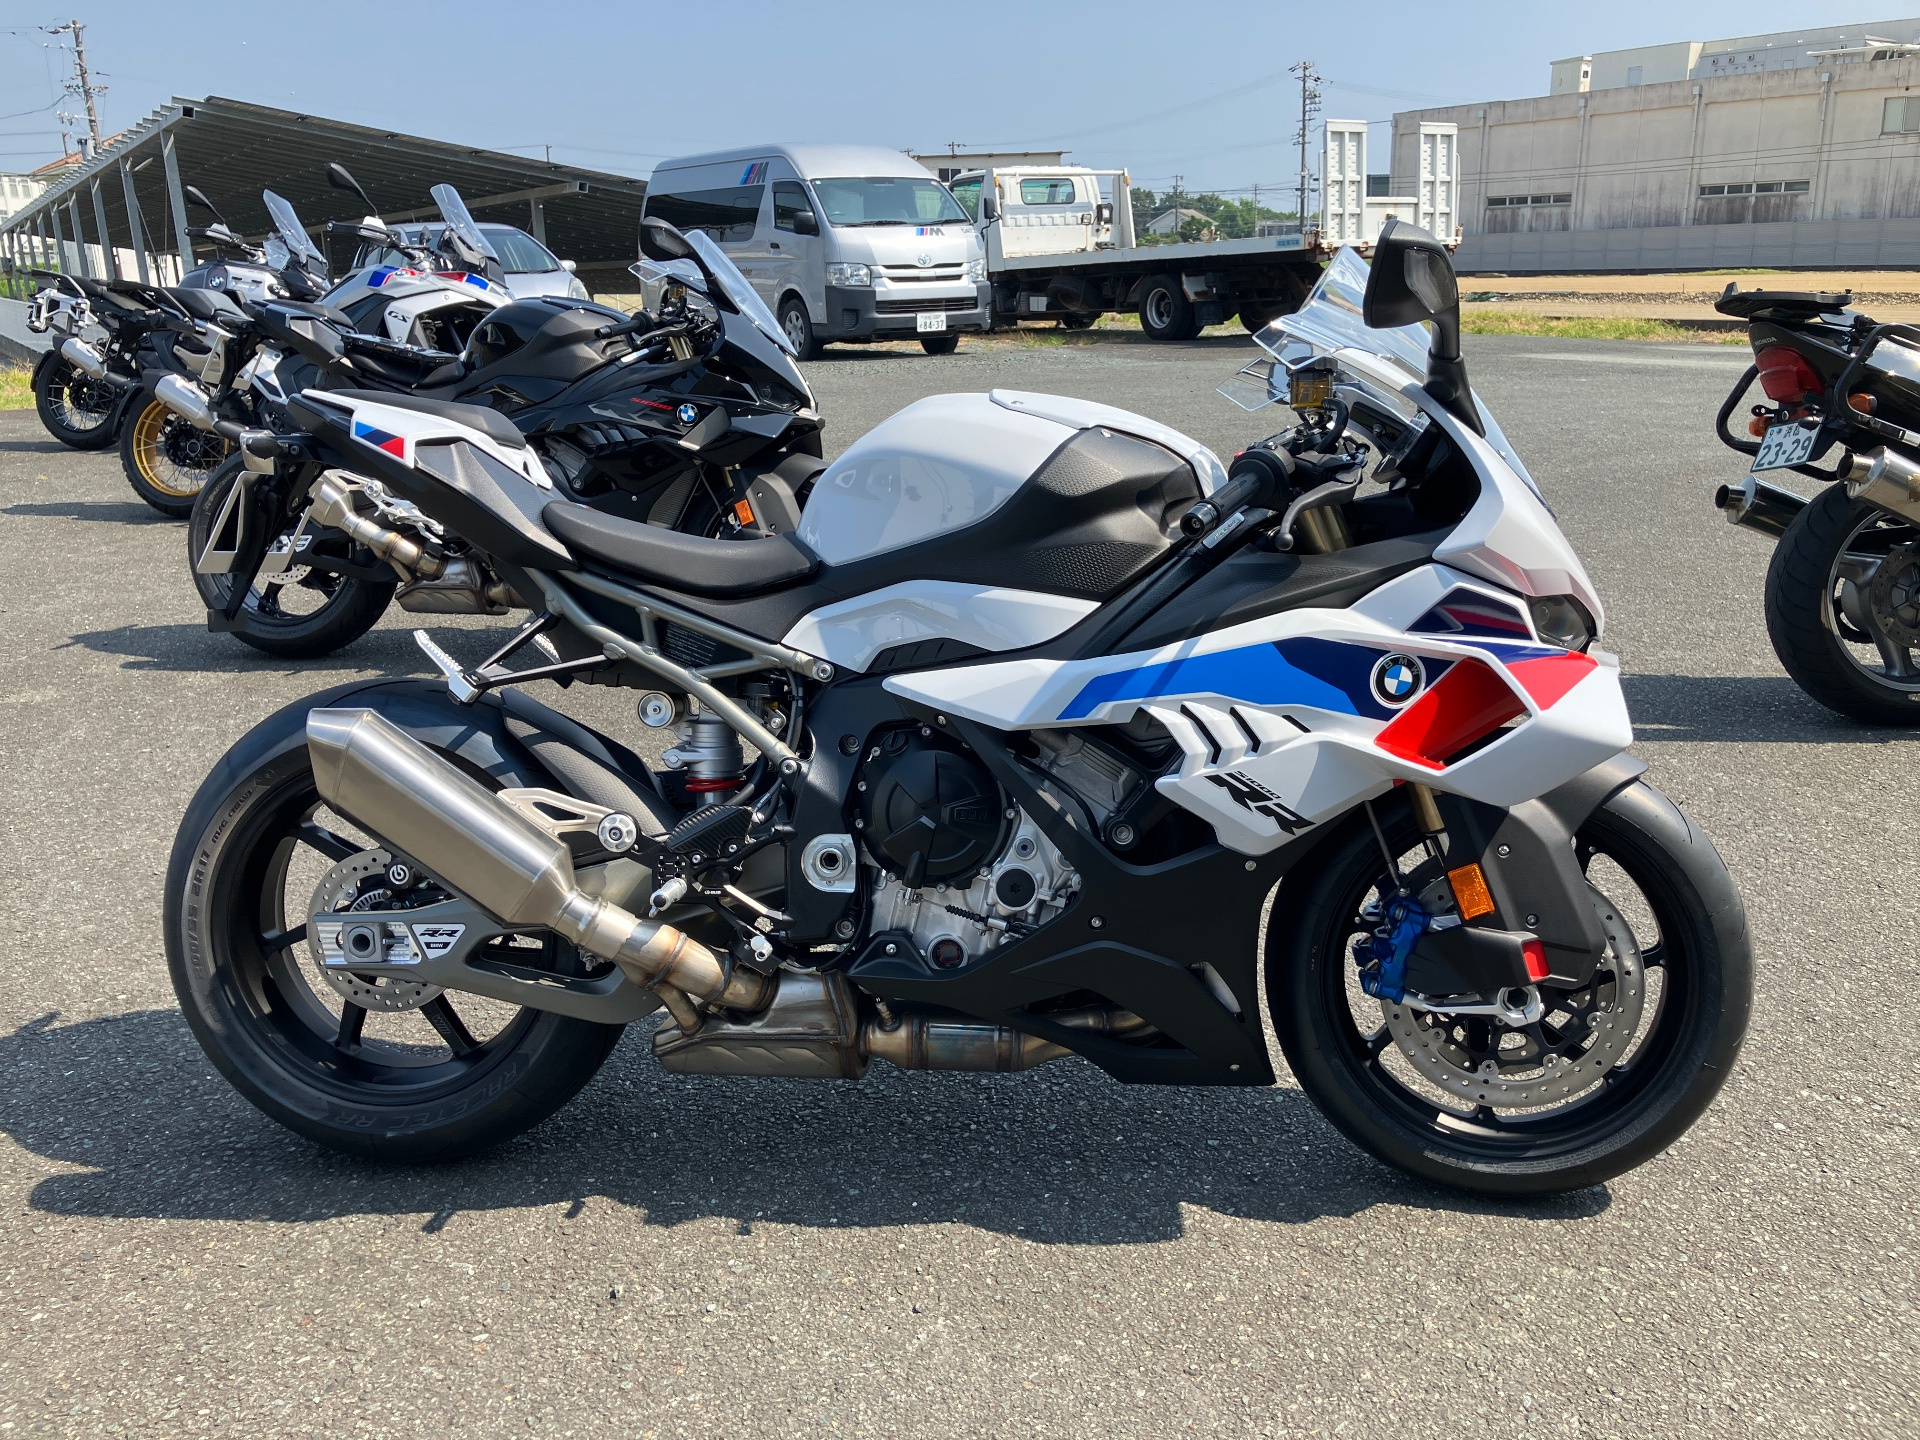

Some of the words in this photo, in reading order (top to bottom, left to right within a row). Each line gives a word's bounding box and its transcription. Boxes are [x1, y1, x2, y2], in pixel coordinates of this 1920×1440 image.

[387, 310, 411, 324] GS
[923, 319, 945, 331] 84-37
[1754, 336, 1778, 347] HONDA
[1754, 434, 1814, 469] 23-29
[1383, 656, 1420, 676] BMW
[1233, 770, 1283, 800] S1000
[1203, 772, 1317, 836] RR
[959, 810, 988, 820] BMW
[386, 1061, 518, 1129] RACETEC
[333, 1112, 378, 1129] RR
